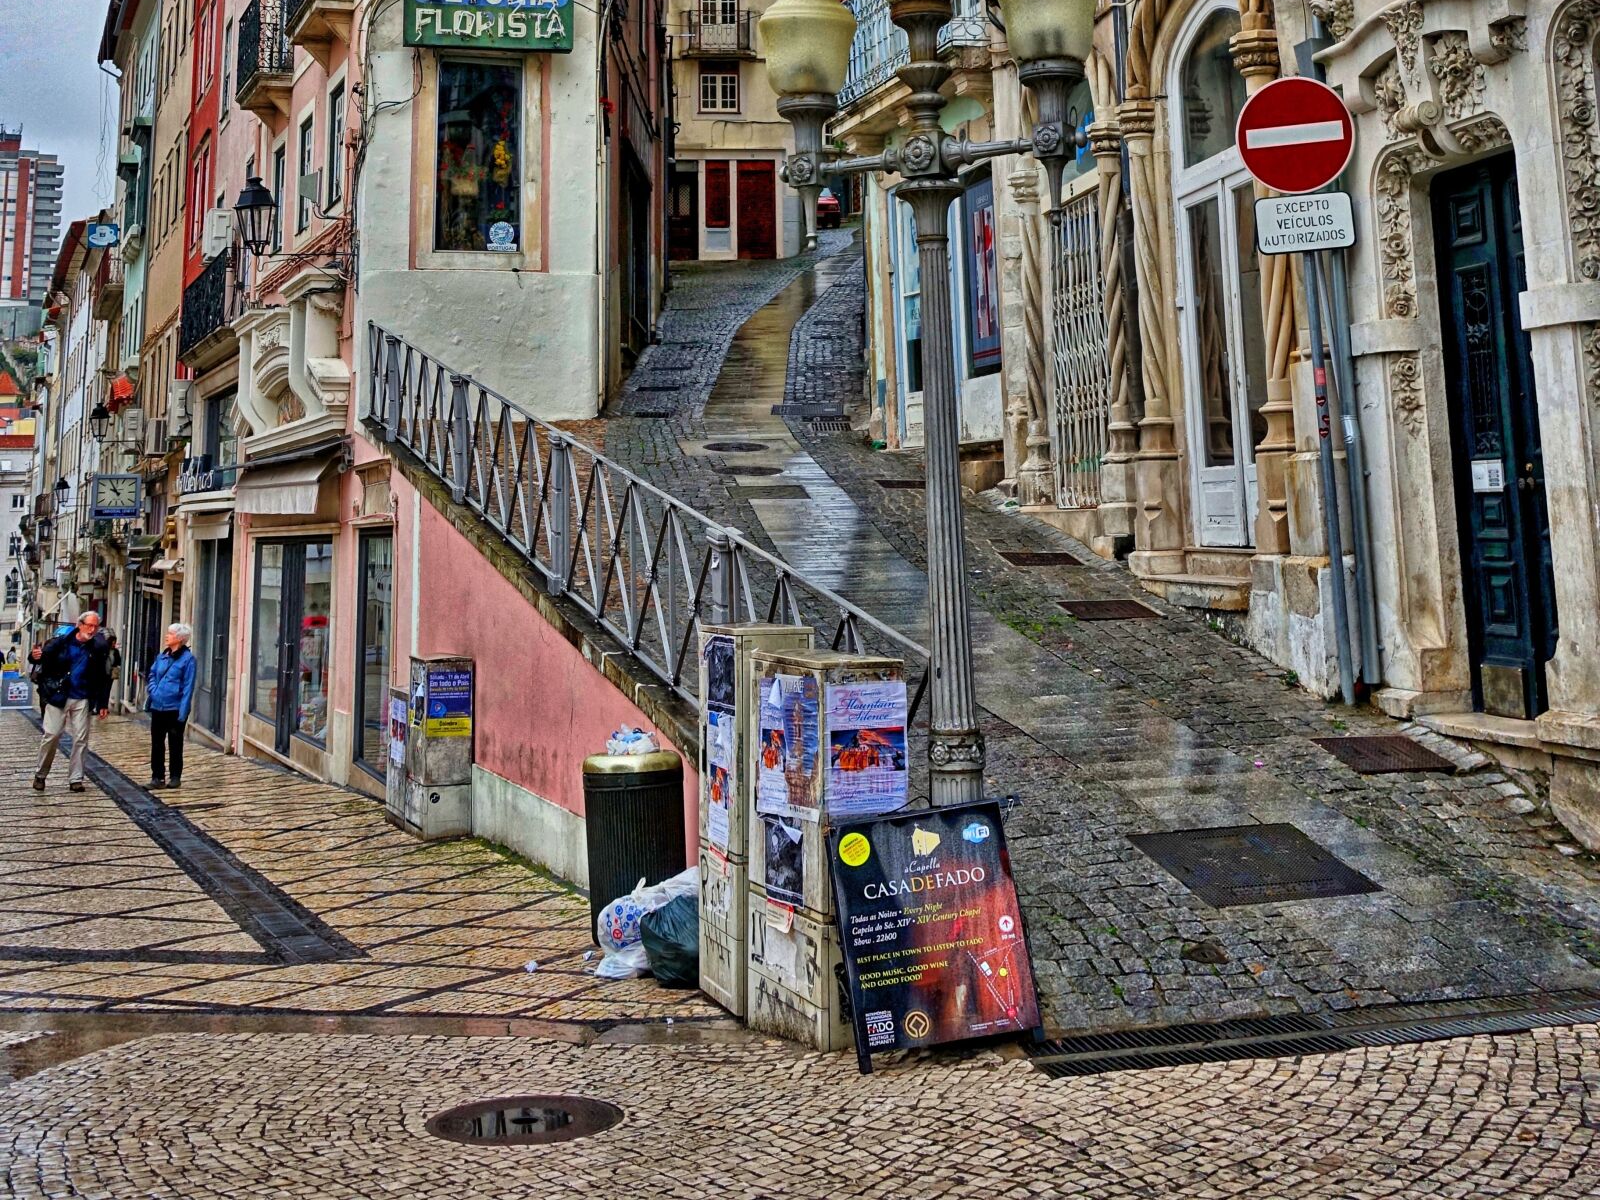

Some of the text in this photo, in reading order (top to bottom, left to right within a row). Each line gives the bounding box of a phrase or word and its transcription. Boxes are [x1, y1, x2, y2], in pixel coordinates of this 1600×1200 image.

[415, 7, 566, 39] FLORISTA
[1276, 199, 1329, 214] EXCEPTO
[1277, 214, 1334, 230] VEÍCULOS
[1264, 229, 1346, 247] AUTORIZADOS
[836, 698, 896, 711] Mountain
[849, 710, 889, 721] Silence
[850, 914, 869, 924] Todas
[878, 910, 898, 919] Noites
[903, 906, 923, 916] Every
[924, 902, 943, 913] Night
[852, 924, 874, 936] Capela
[875, 924, 883, 932] do
[897, 918, 912, 928] XIV
[917, 915, 932, 925] XIV
[932, 911, 959, 922] Century
[959, 907, 982, 919] Chapel
[853, 932, 897, 947] Show 22h00
[872, 953, 892, 961] PLACE
[902, 948, 922, 957] TOWN
[933, 943, 955, 951] LISTEN
[965, 938, 984, 946] FADO
[859, 972, 881, 981] GOOD
[907, 963, 929, 973] GOOD
[930, 960, 949, 968] WINE
[860, 981, 876, 989] AND
[877, 977, 899, 987] GOOD
[867, 1021, 894, 1034] FADO
